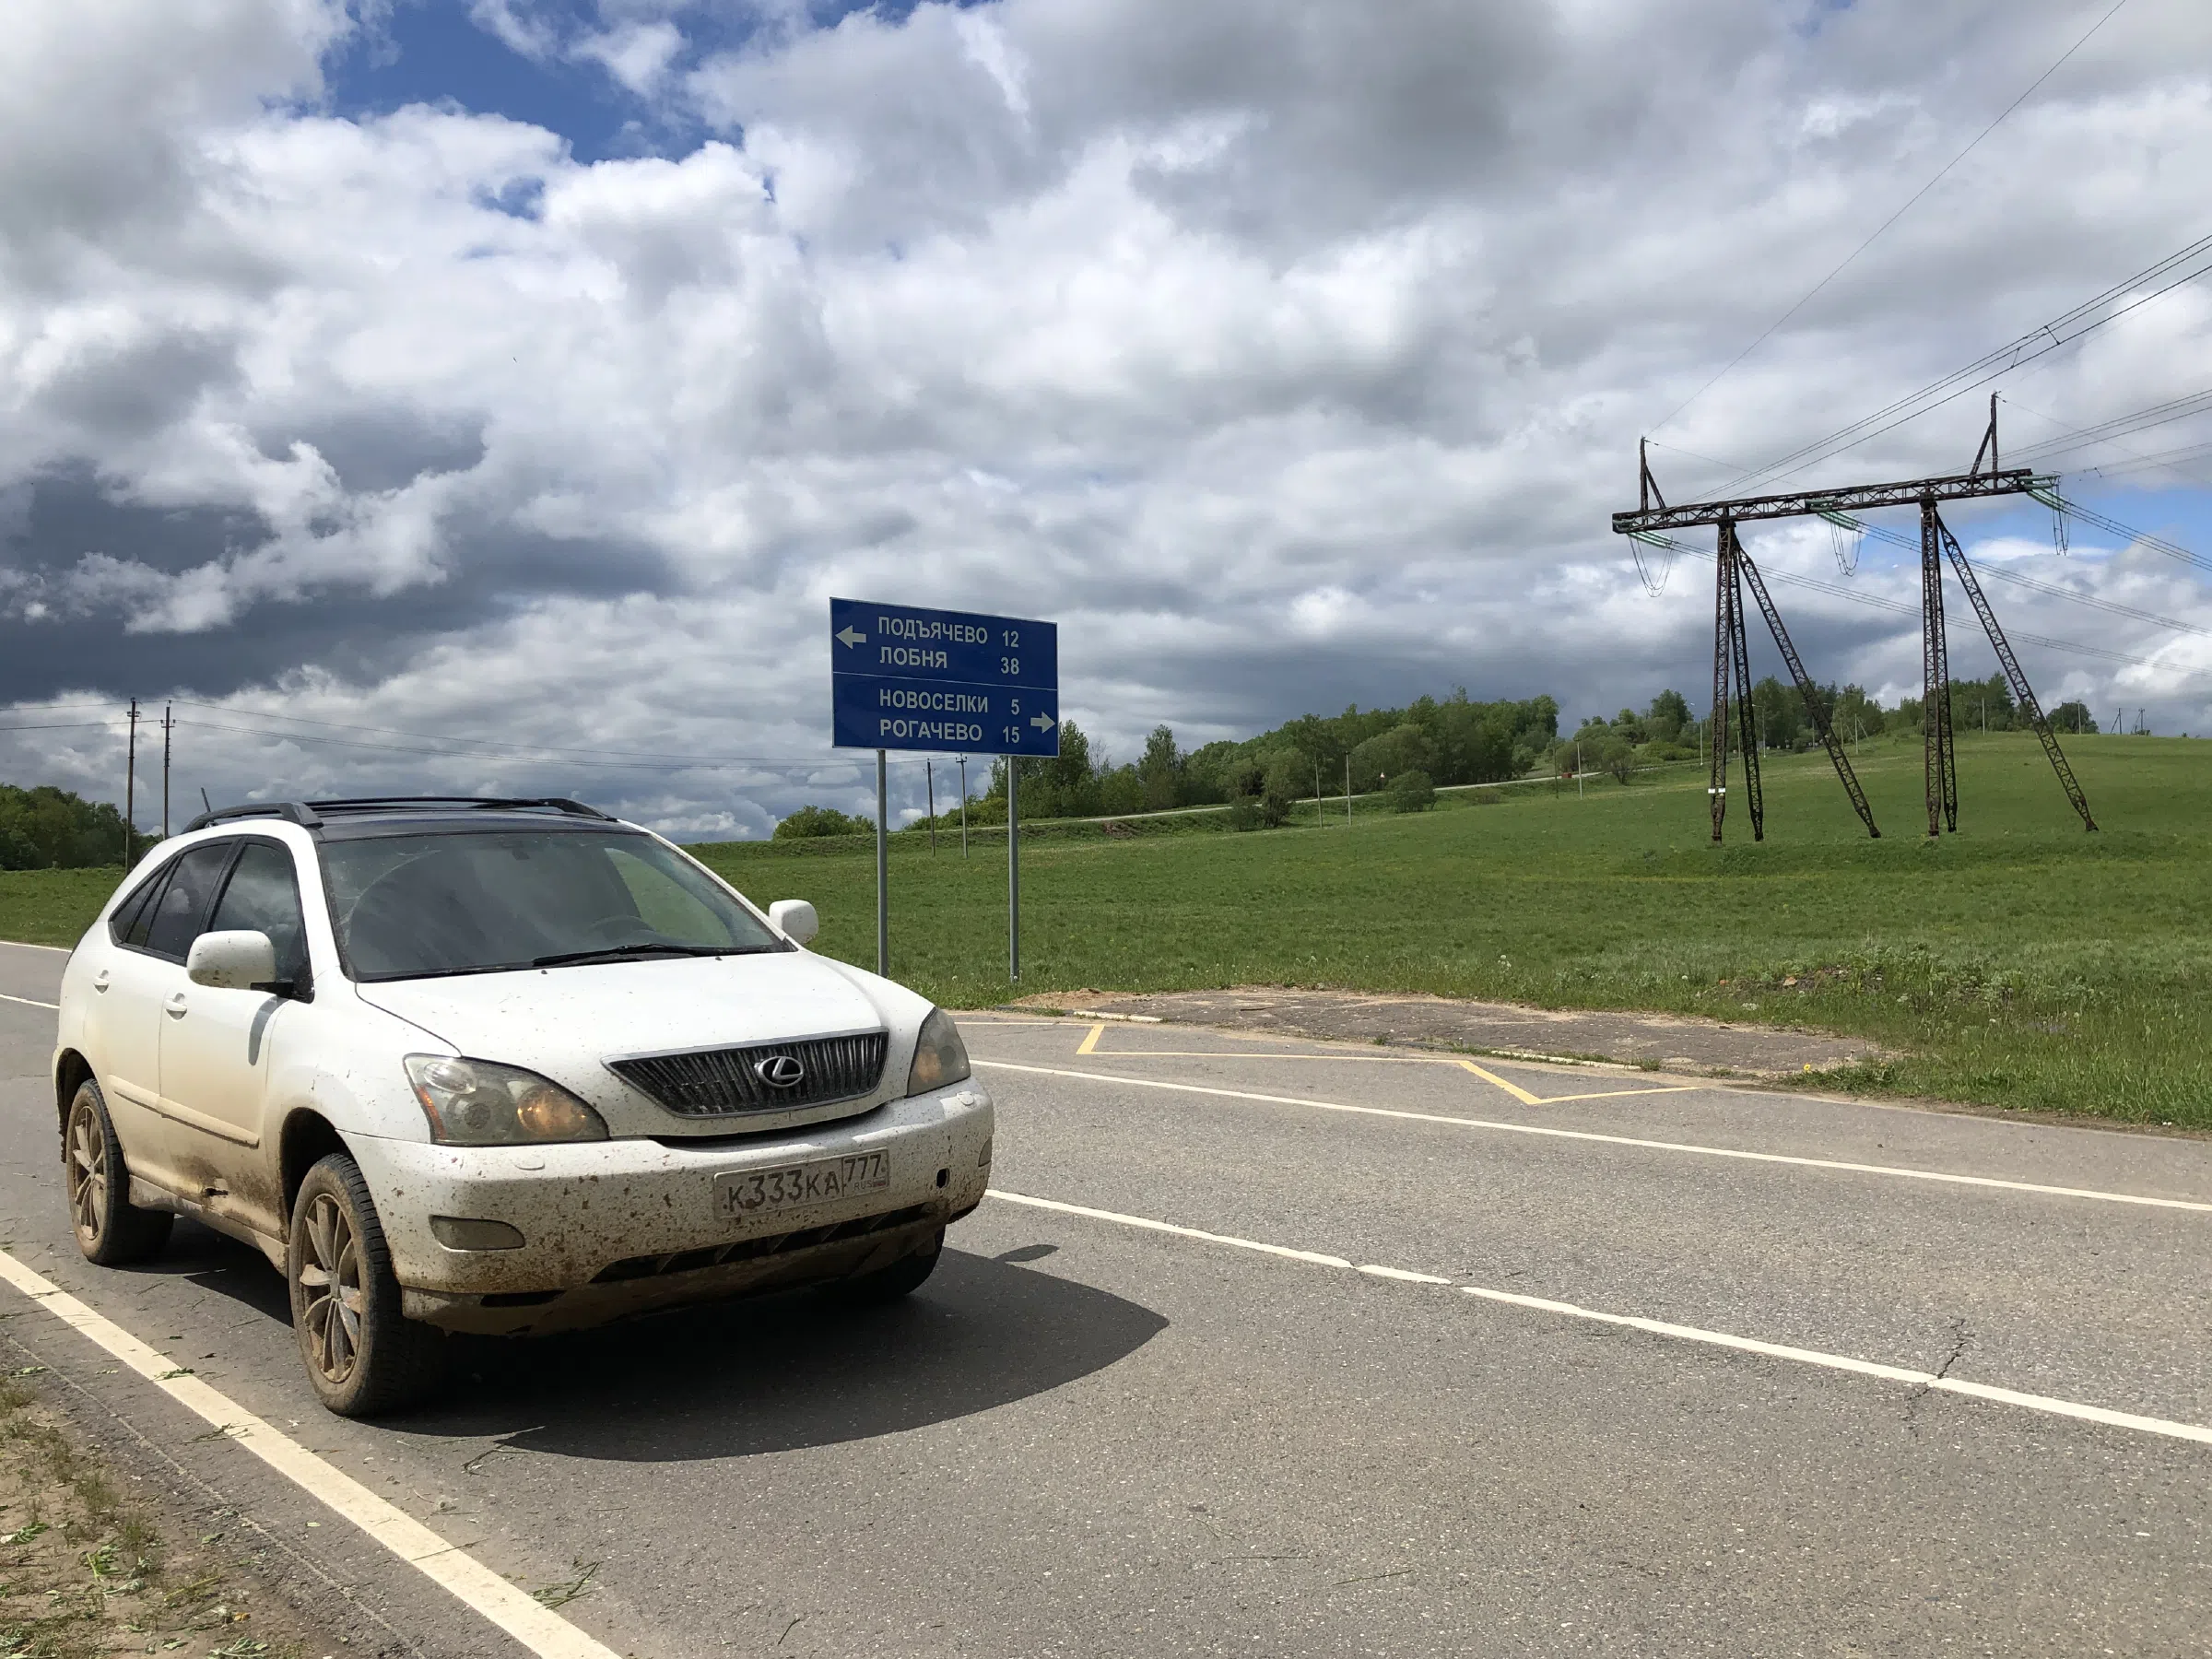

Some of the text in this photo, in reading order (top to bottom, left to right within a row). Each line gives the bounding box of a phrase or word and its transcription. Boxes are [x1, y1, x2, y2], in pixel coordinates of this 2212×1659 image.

[878, 616, 1019, 648] ПОДЪЯЧЕВО 12
[879, 646, 1020, 675] ЛОБНЯ 38
[879, 688, 1019, 715] НОВОСЕЛКИ 5
[880, 719, 1020, 744] РОГАЧЕВО 15
[853, 1180, 873, 1191] RUS
